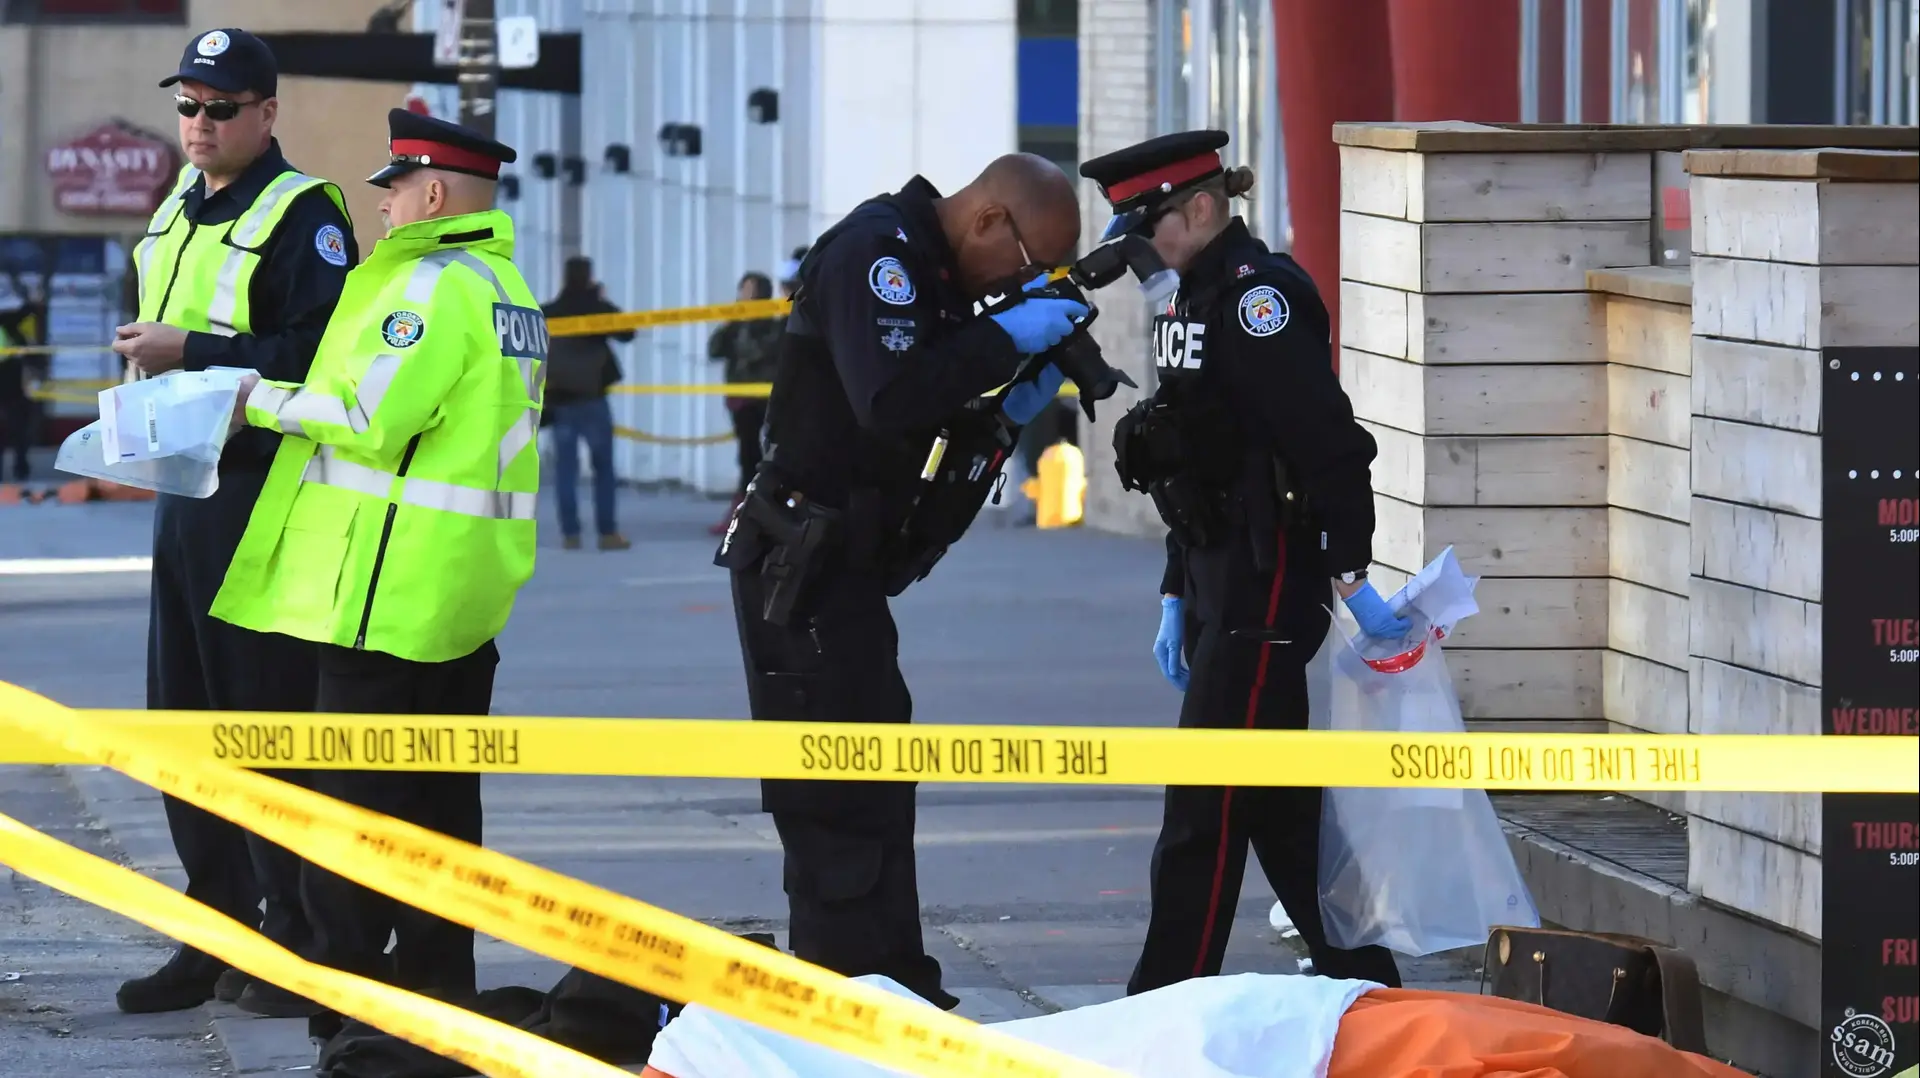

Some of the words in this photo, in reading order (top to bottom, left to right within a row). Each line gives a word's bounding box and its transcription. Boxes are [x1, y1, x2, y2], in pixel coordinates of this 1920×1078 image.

[1242, 290, 1274, 308] TORONTO
[392, 312, 423, 325] TORONTO
[1257, 319, 1282, 333] POLICE
[387, 336, 409, 346] POLICE
[1152, 321, 1205, 369] LICE
[213, 723, 294, 760] CROSS
[304, 725, 353, 762] NOT
[364, 727, 395, 764] DO
[403, 727, 456, 763] LINE
[467, 728, 519, 764] FIRE
[800, 734, 883, 772] CROSS
[893, 736, 941, 773] NOT
[951, 739, 983, 775] DO
[990, 738, 1044, 774] LINE
[1055, 740, 1108, 775] FIRE
[1390, 743, 1473, 780] CROSS
[1484, 746, 1532, 781] NOT
[1543, 748, 1575, 782] DO
[1583, 747, 1636, 781] LINE
[1647, 748, 1701, 782] FIRE
[1882, 938, 1917, 965] FRI
[1851, 1019, 1880, 1029] KOREAN
[1830, 1026, 1895, 1069] ssam
